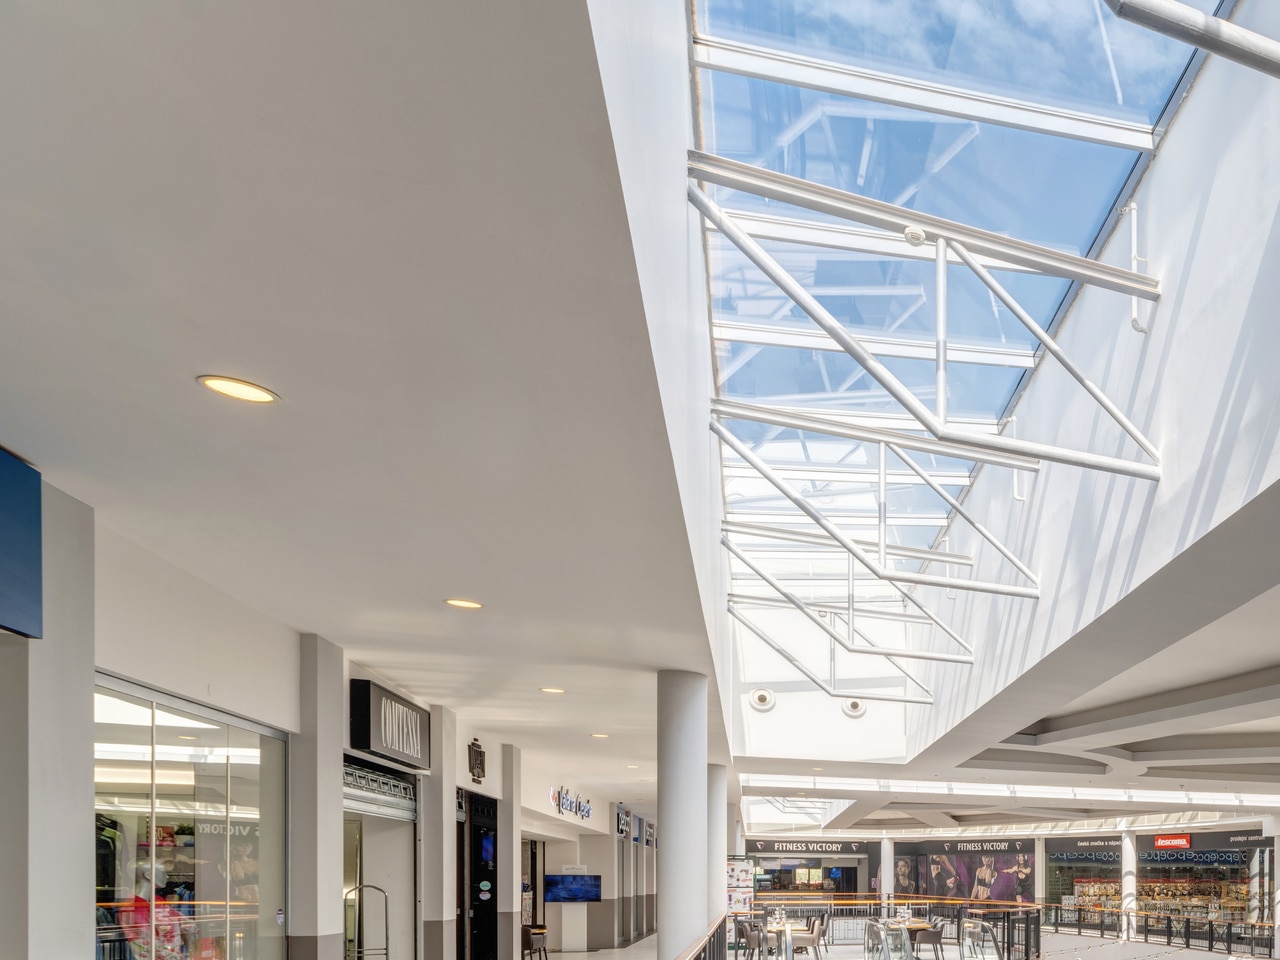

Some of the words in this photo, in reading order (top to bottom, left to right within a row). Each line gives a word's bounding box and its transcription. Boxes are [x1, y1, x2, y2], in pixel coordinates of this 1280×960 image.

[381, 696, 421, 759] COMTESSA
[774, 842, 806, 851] FITNESS
[808, 842, 843, 852] VICTORY
[957, 842, 982, 851] FITNESS
[982, 841, 1009, 851] VICTORY
